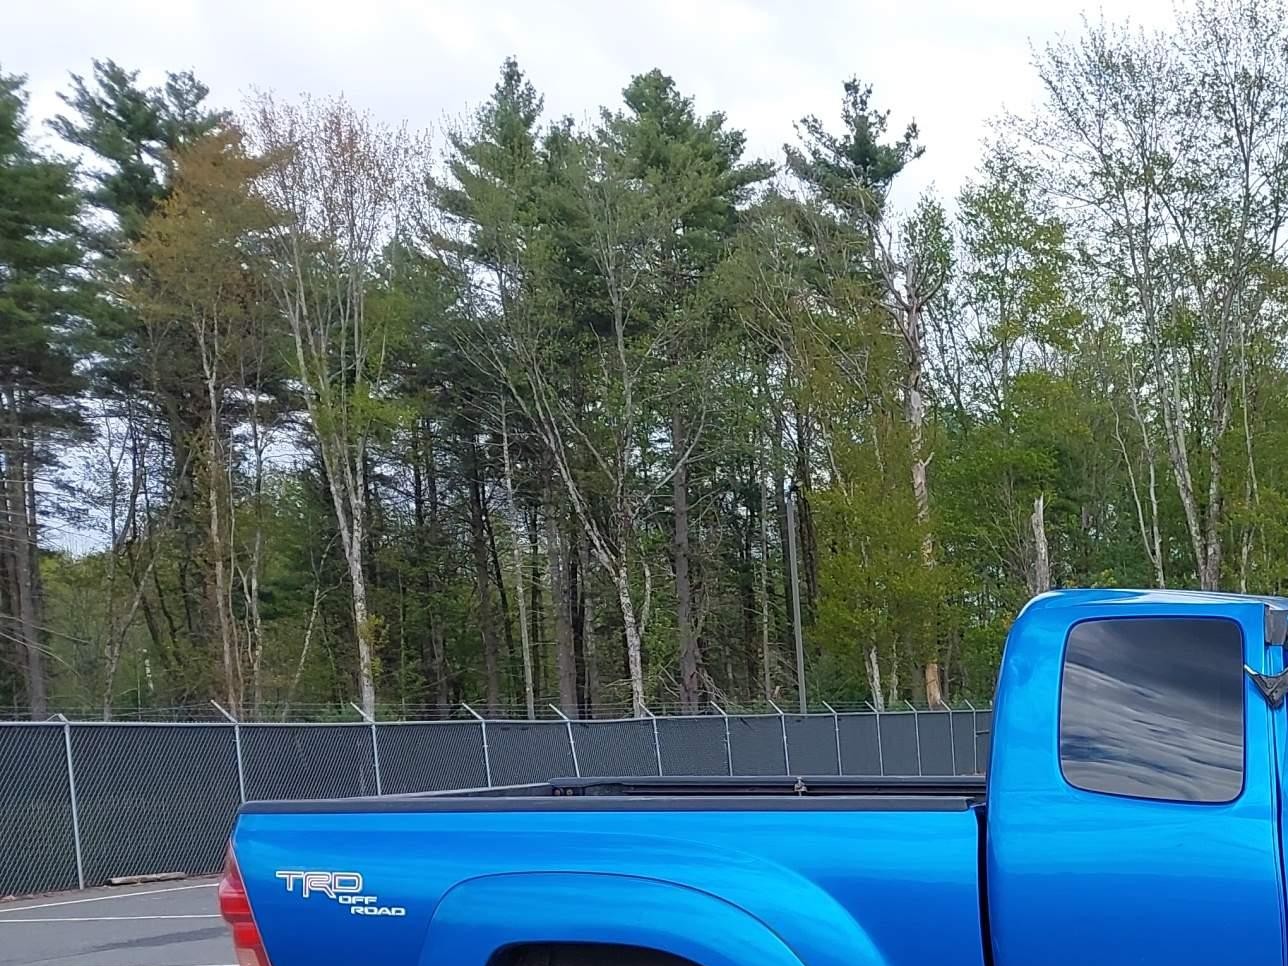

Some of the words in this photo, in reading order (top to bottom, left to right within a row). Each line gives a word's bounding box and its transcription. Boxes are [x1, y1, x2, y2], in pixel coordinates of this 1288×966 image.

[275, 870, 363, 898] TRD
[338, 895, 377, 905] OFF
[350, 905, 406, 916] ROAD
